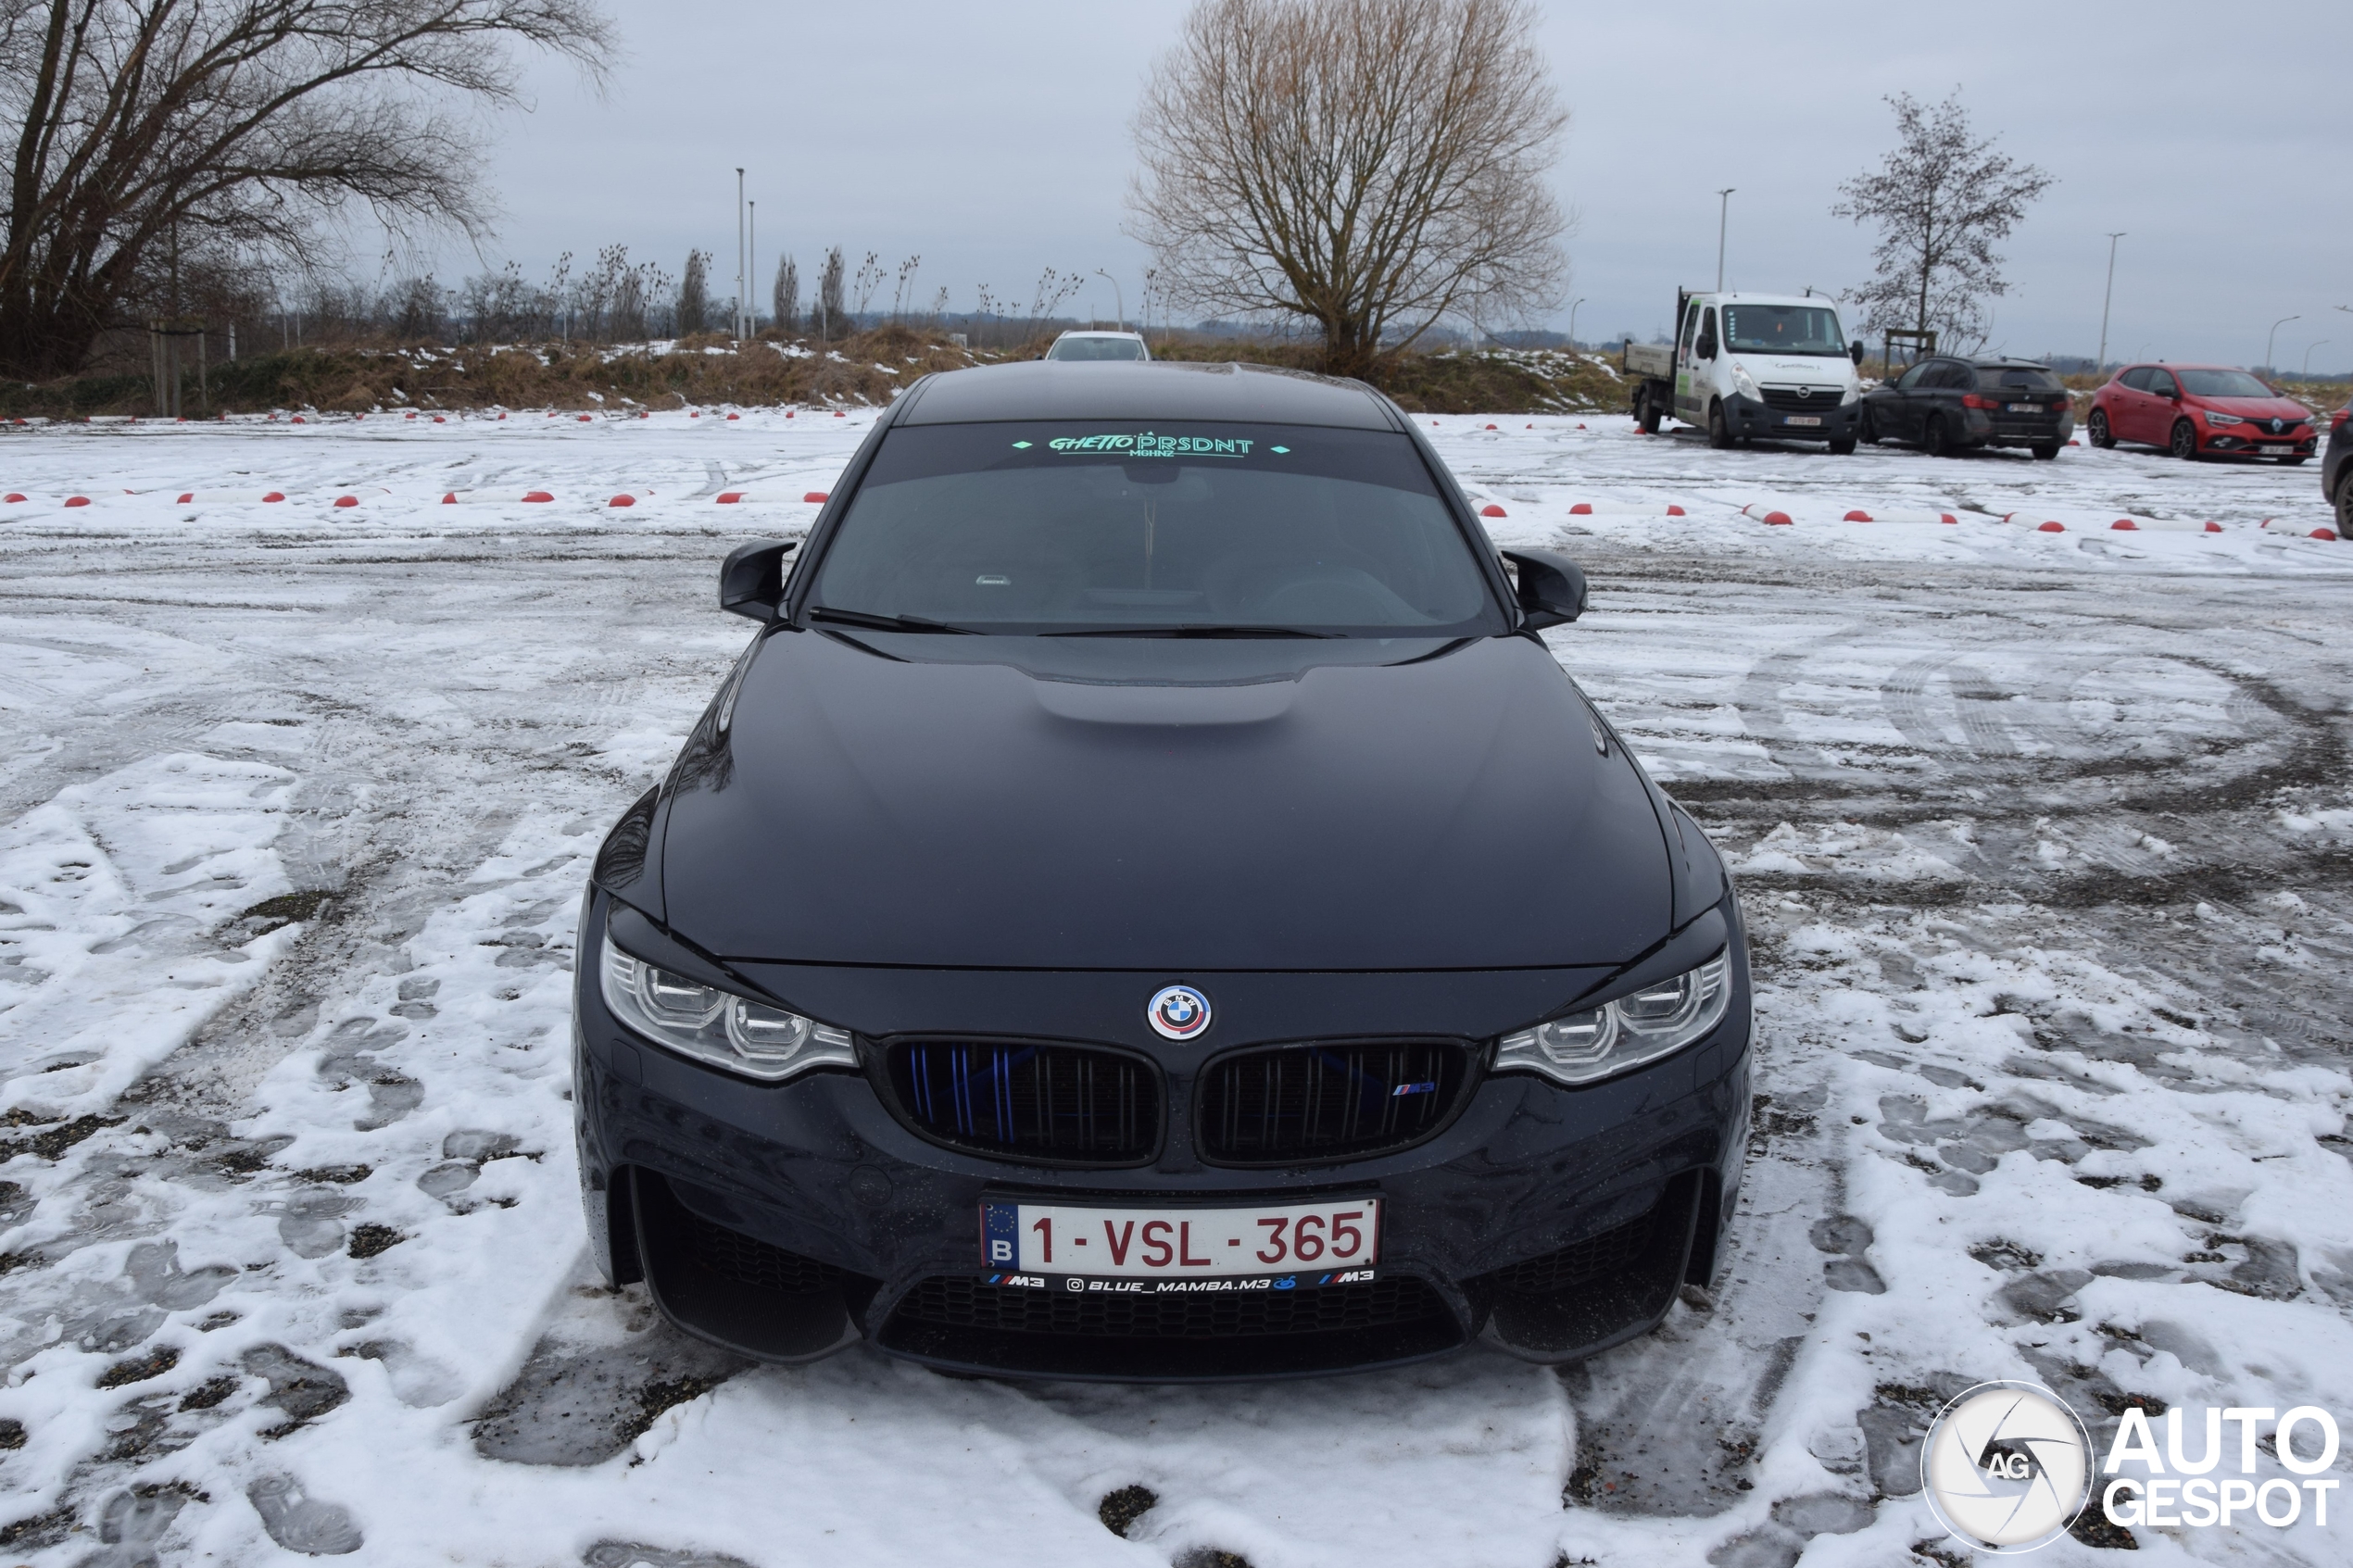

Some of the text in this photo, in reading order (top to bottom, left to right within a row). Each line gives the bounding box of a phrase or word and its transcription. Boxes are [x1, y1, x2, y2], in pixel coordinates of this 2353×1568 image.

[1049, 434, 1254, 454] GHETTO PRSDNT
[1164, 995, 1196, 1007] BMW
[991, 1239, 1013, 1261] B
[1008, 1275, 1045, 1287] M3
[1338, 1270, 1375, 1282] M3
[1088, 1279, 1271, 1294] BLUE_MAMBA.M3
